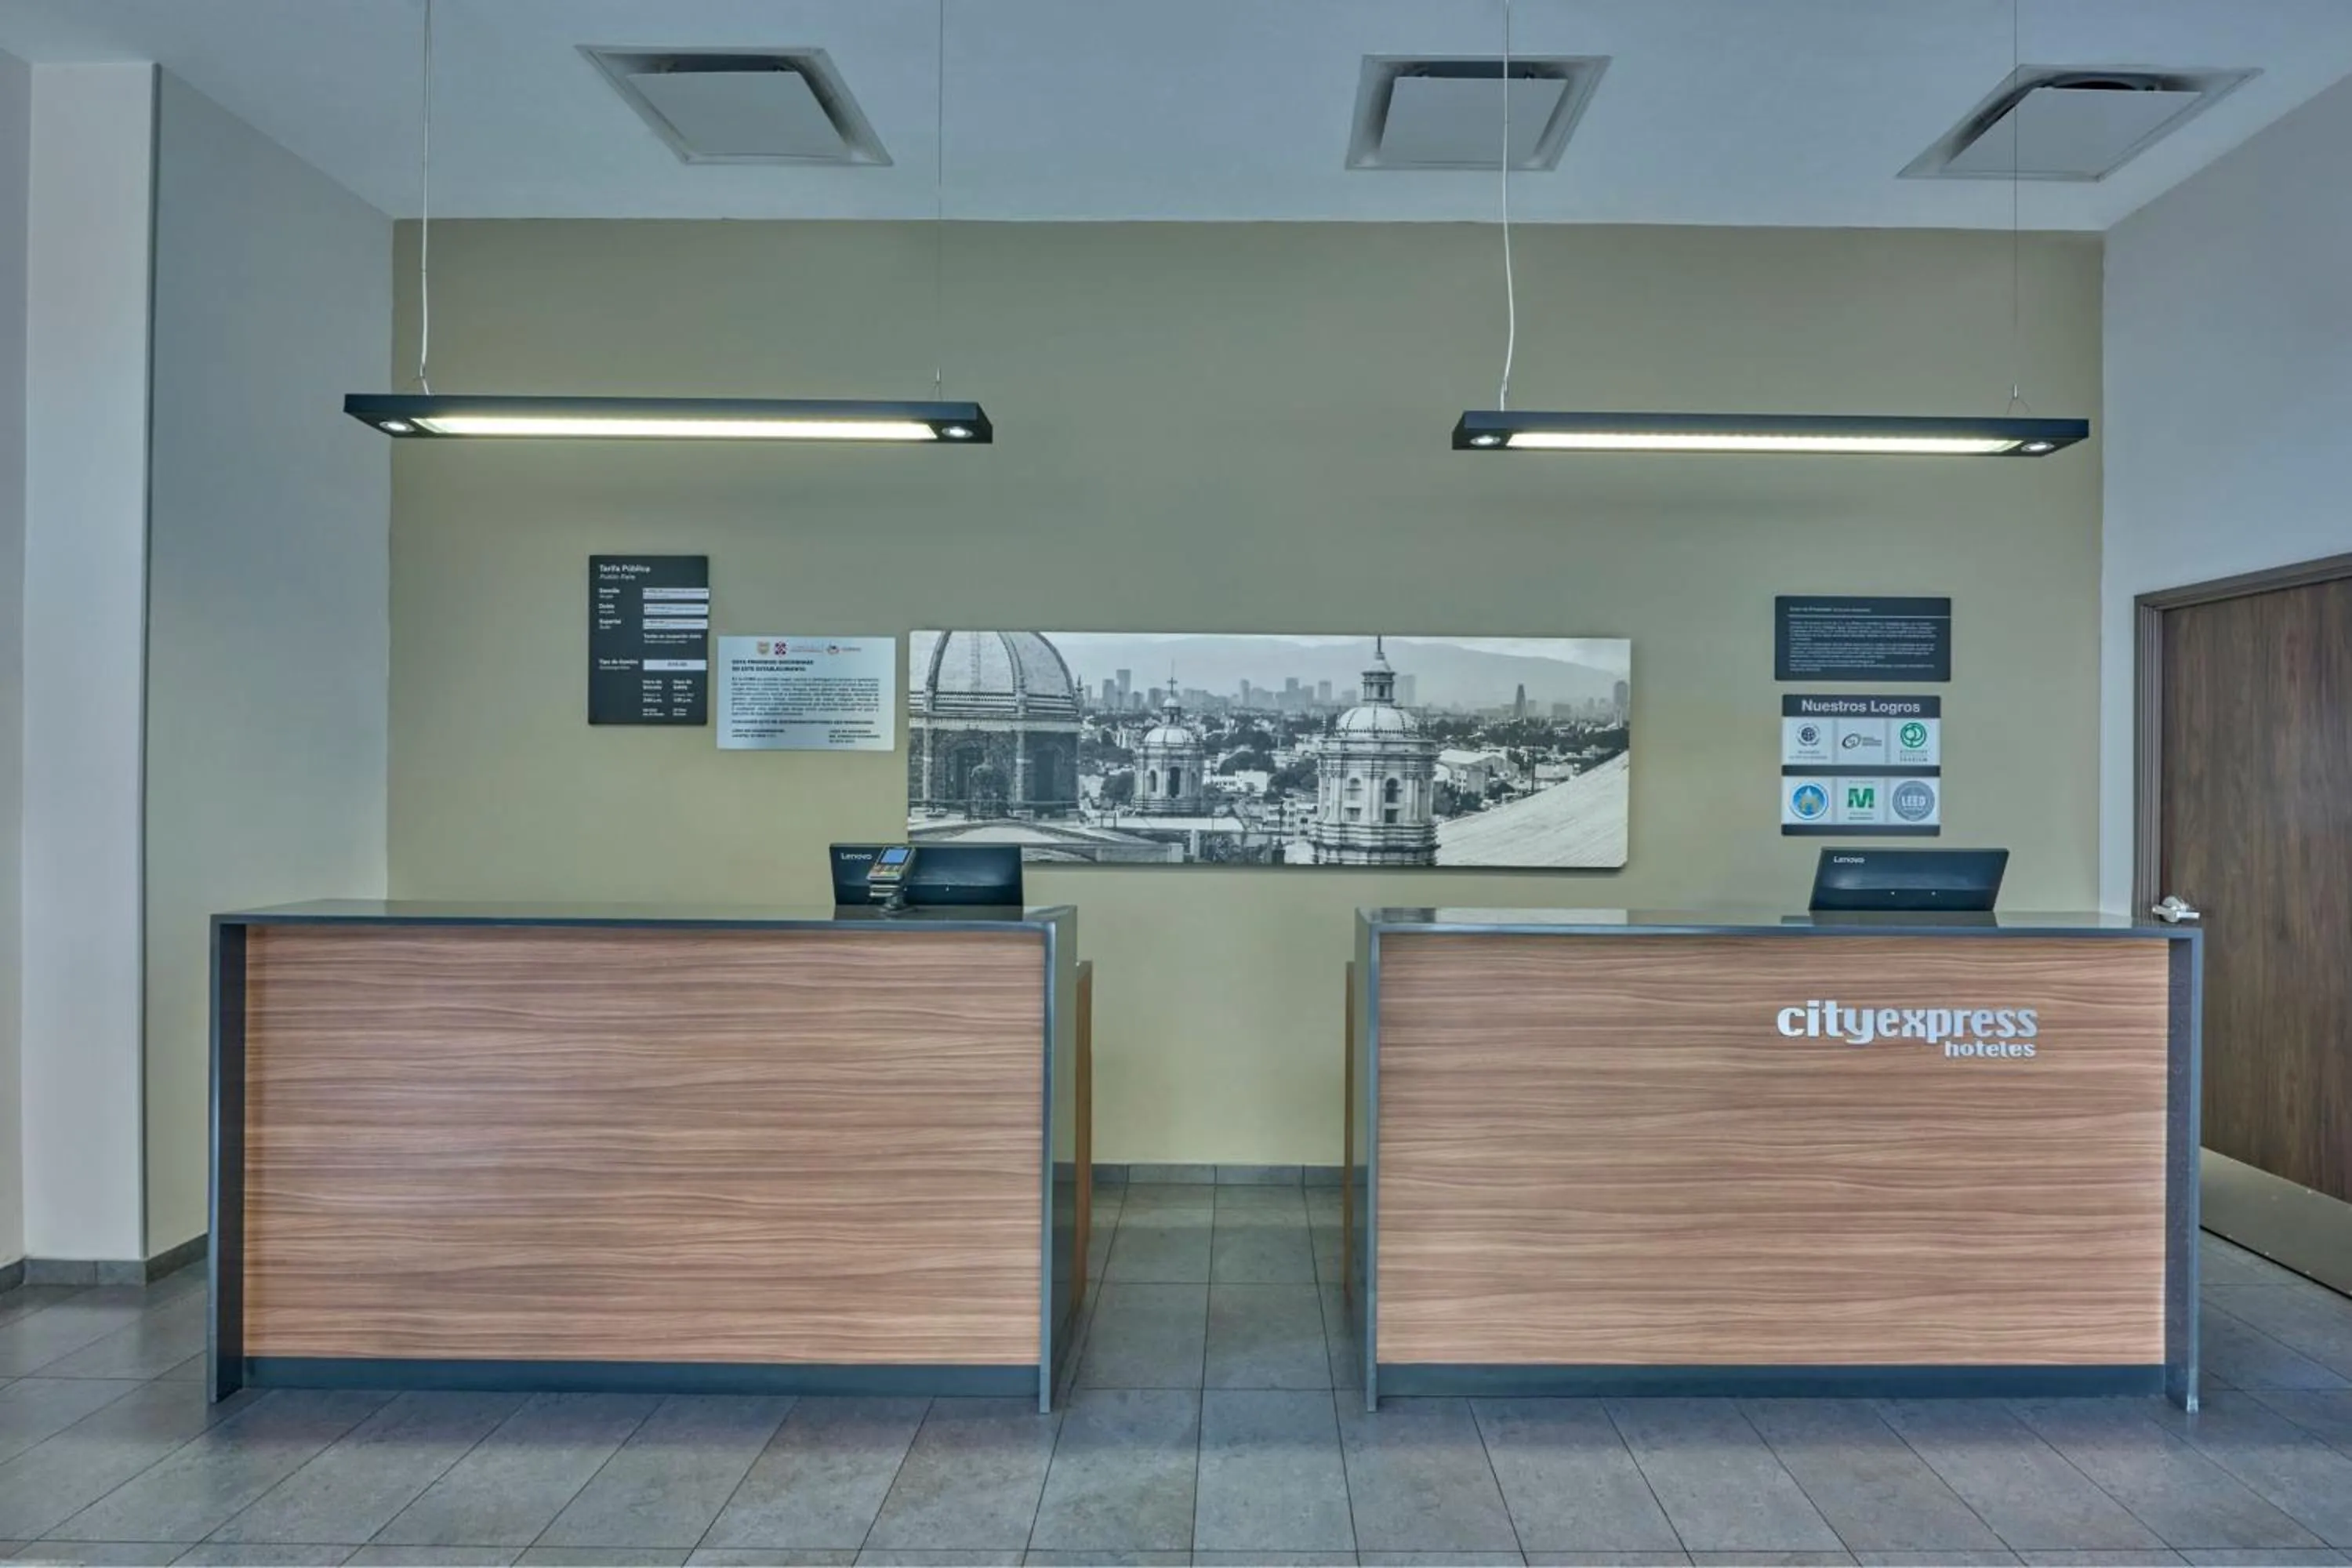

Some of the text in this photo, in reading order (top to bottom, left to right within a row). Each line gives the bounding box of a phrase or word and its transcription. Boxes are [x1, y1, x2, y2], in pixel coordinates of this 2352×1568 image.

[599, 564, 620, 572] Tarifa
[1802, 699, 1921, 715] Nuestros Logros
[1847, 788, 1875, 808] M
[840, 852, 873, 861] Lenovo
[1777, 1000, 2038, 1044] cityexpress
[1944, 1040, 2037, 1058] hoteles
